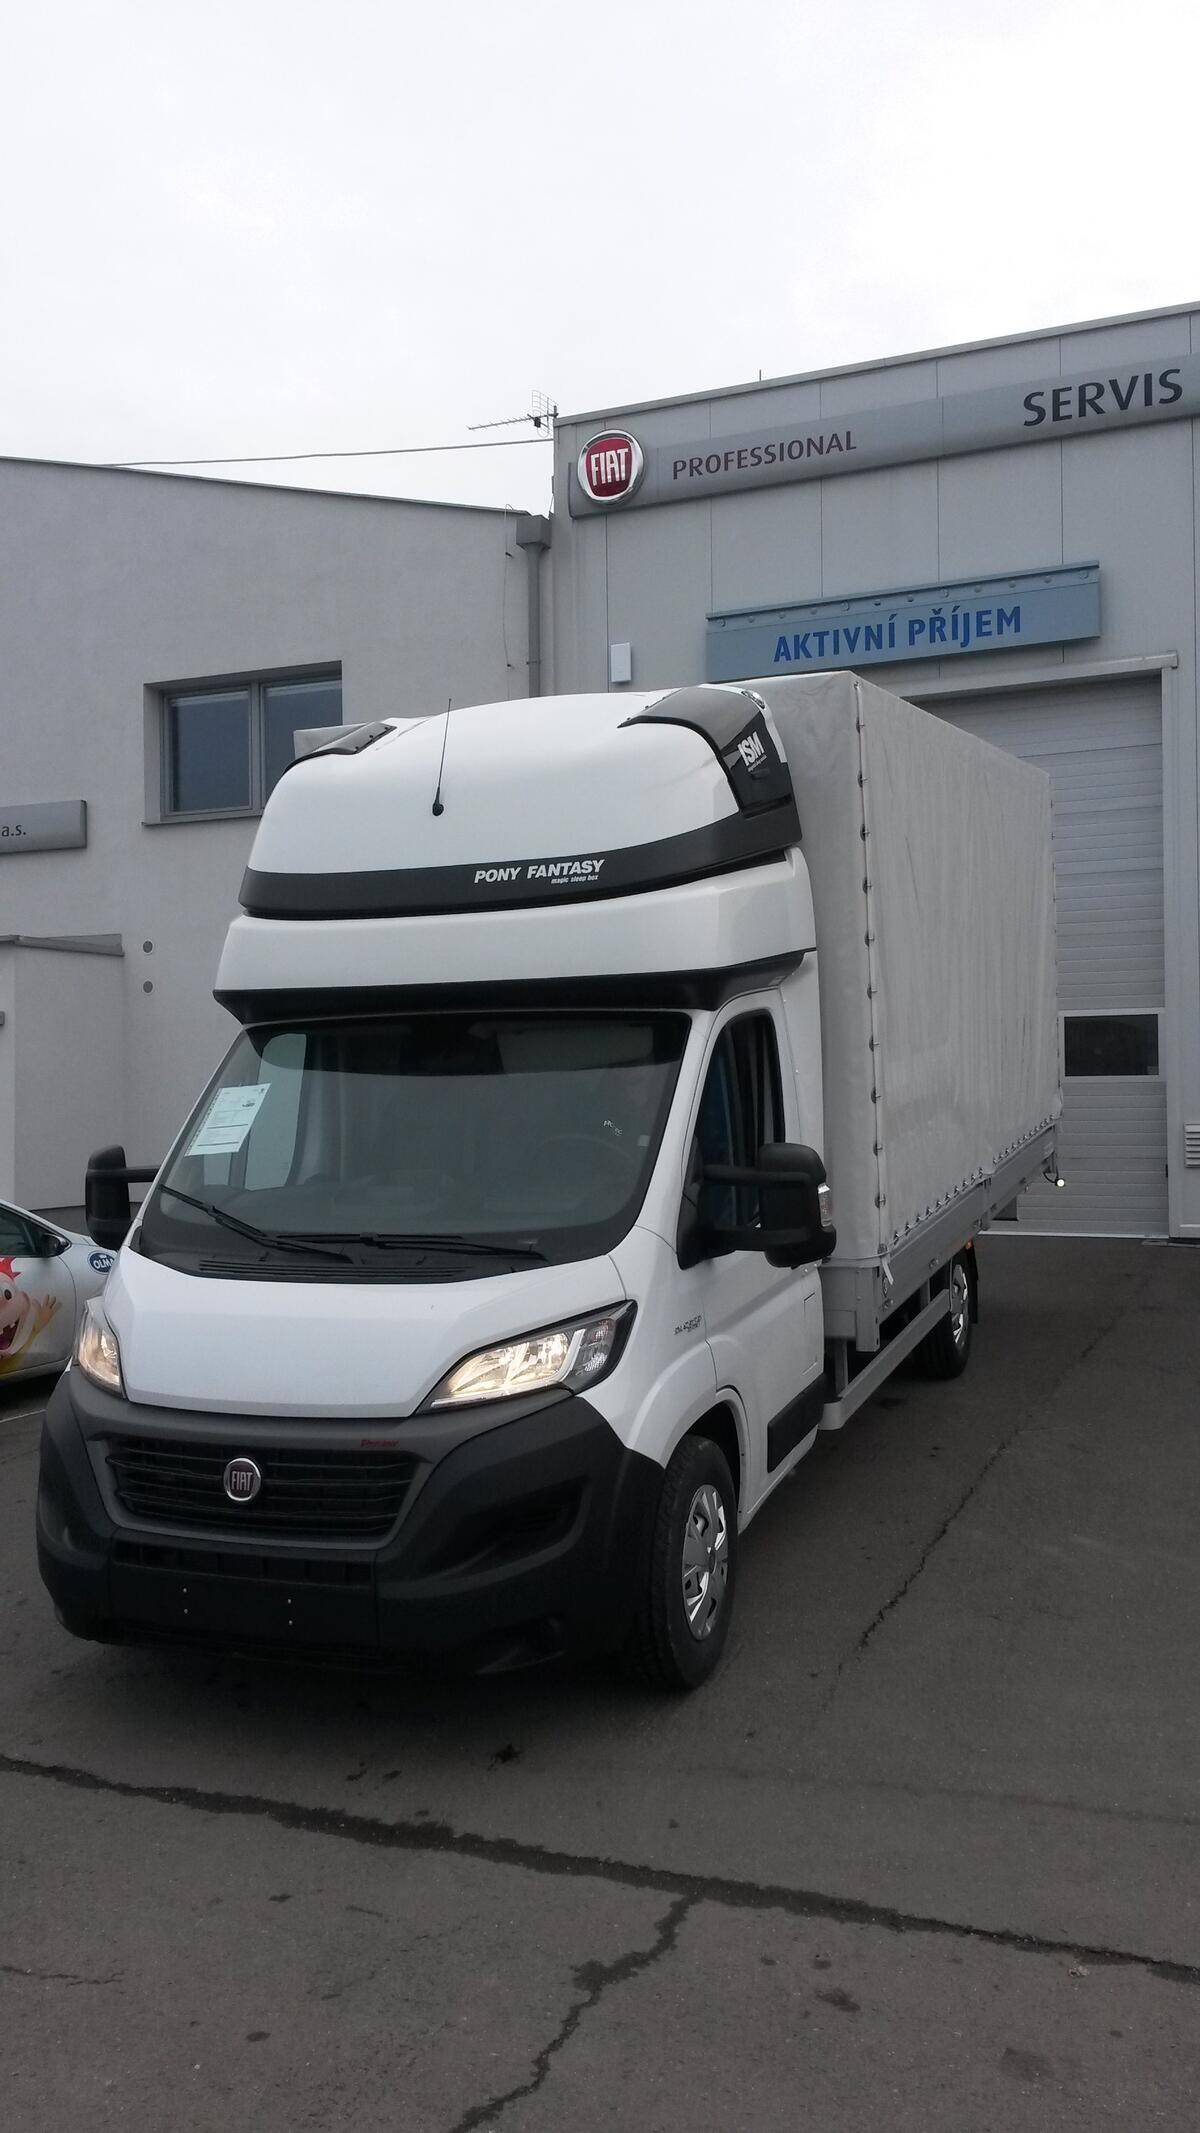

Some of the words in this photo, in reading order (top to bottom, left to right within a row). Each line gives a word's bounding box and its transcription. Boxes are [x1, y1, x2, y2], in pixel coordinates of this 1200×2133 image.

[1023, 368, 1183, 427] SERVIS
[590, 447, 629, 487] FIAT
[672, 430, 857, 480] PROFESSIONAL
[773, 613, 898, 663] AKTIVNÍ
[907, 605, 1021, 648] PŘÍJEM
[737, 731, 765, 767] ISM
[1, 824, 27, 837] a.s.
[474, 866, 522, 884] PONY
[526, 859, 605, 879] FANTASY
[93, 1257, 114, 1269] OLM
[231, 1470, 254, 1491] FIAT
